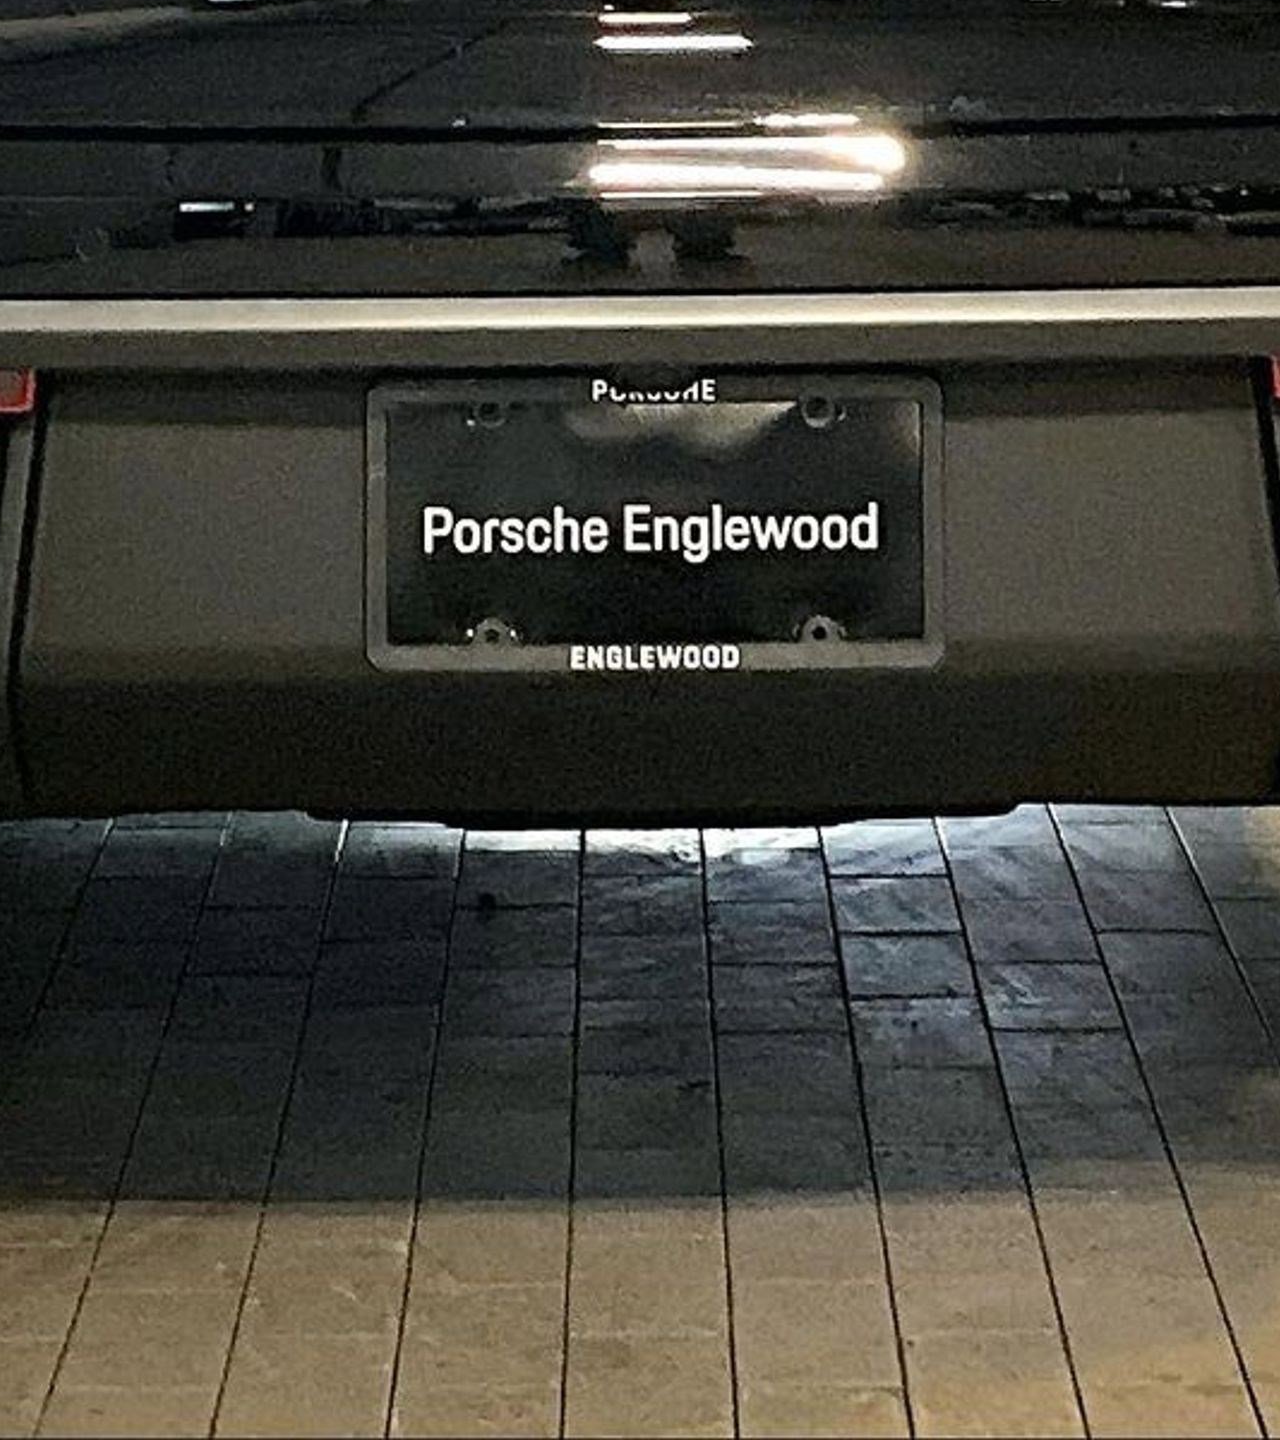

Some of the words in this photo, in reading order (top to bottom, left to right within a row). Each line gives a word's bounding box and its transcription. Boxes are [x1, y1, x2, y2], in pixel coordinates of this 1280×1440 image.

[423, 505, 610, 554] Porsche
[623, 501, 880, 563] Englewood
[569, 645, 741, 671] ENGLEWOOD
